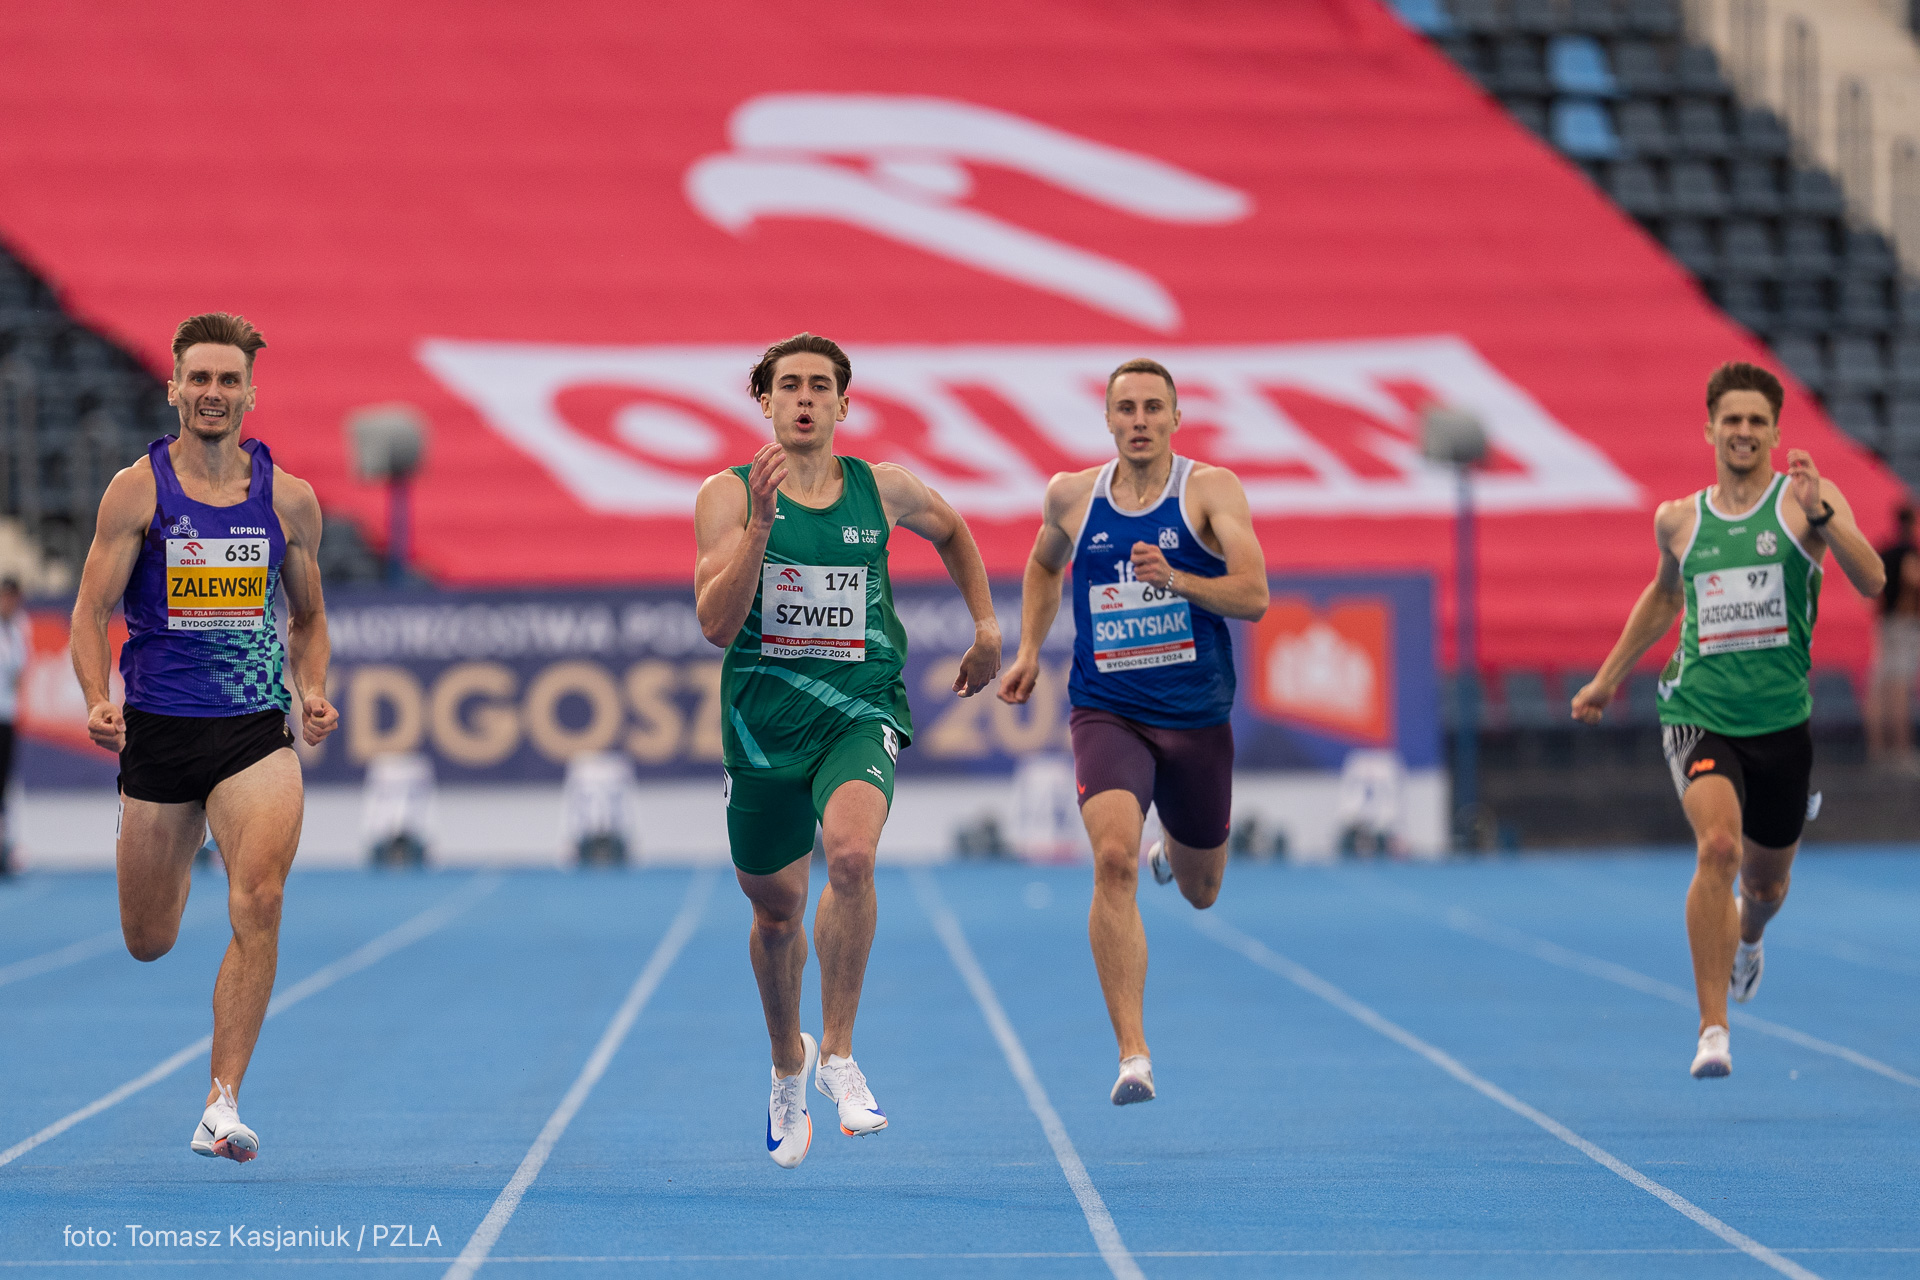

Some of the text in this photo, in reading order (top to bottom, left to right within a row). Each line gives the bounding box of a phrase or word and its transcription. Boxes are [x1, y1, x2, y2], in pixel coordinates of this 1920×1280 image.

[230, 526, 266, 535] KIPRUN
[225, 544, 261, 562] 635
[171, 577, 263, 598] ZALEWSKI
[825, 572, 859, 591] 174
[1747, 570, 1768, 588] 97
[776, 584, 804, 593] ORLEN
[1100, 602, 1124, 611] ORLEN
[181, 619, 255, 628] BYDGOSZCZ 2024
[775, 603, 854, 628] SZWED
[1096, 611, 1188, 642] SOŁTYSIAK
[773, 647, 851, 658] BYDGOSZCZ 2024
[1106, 652, 1183, 669] BYDGOSZCZ 2024
